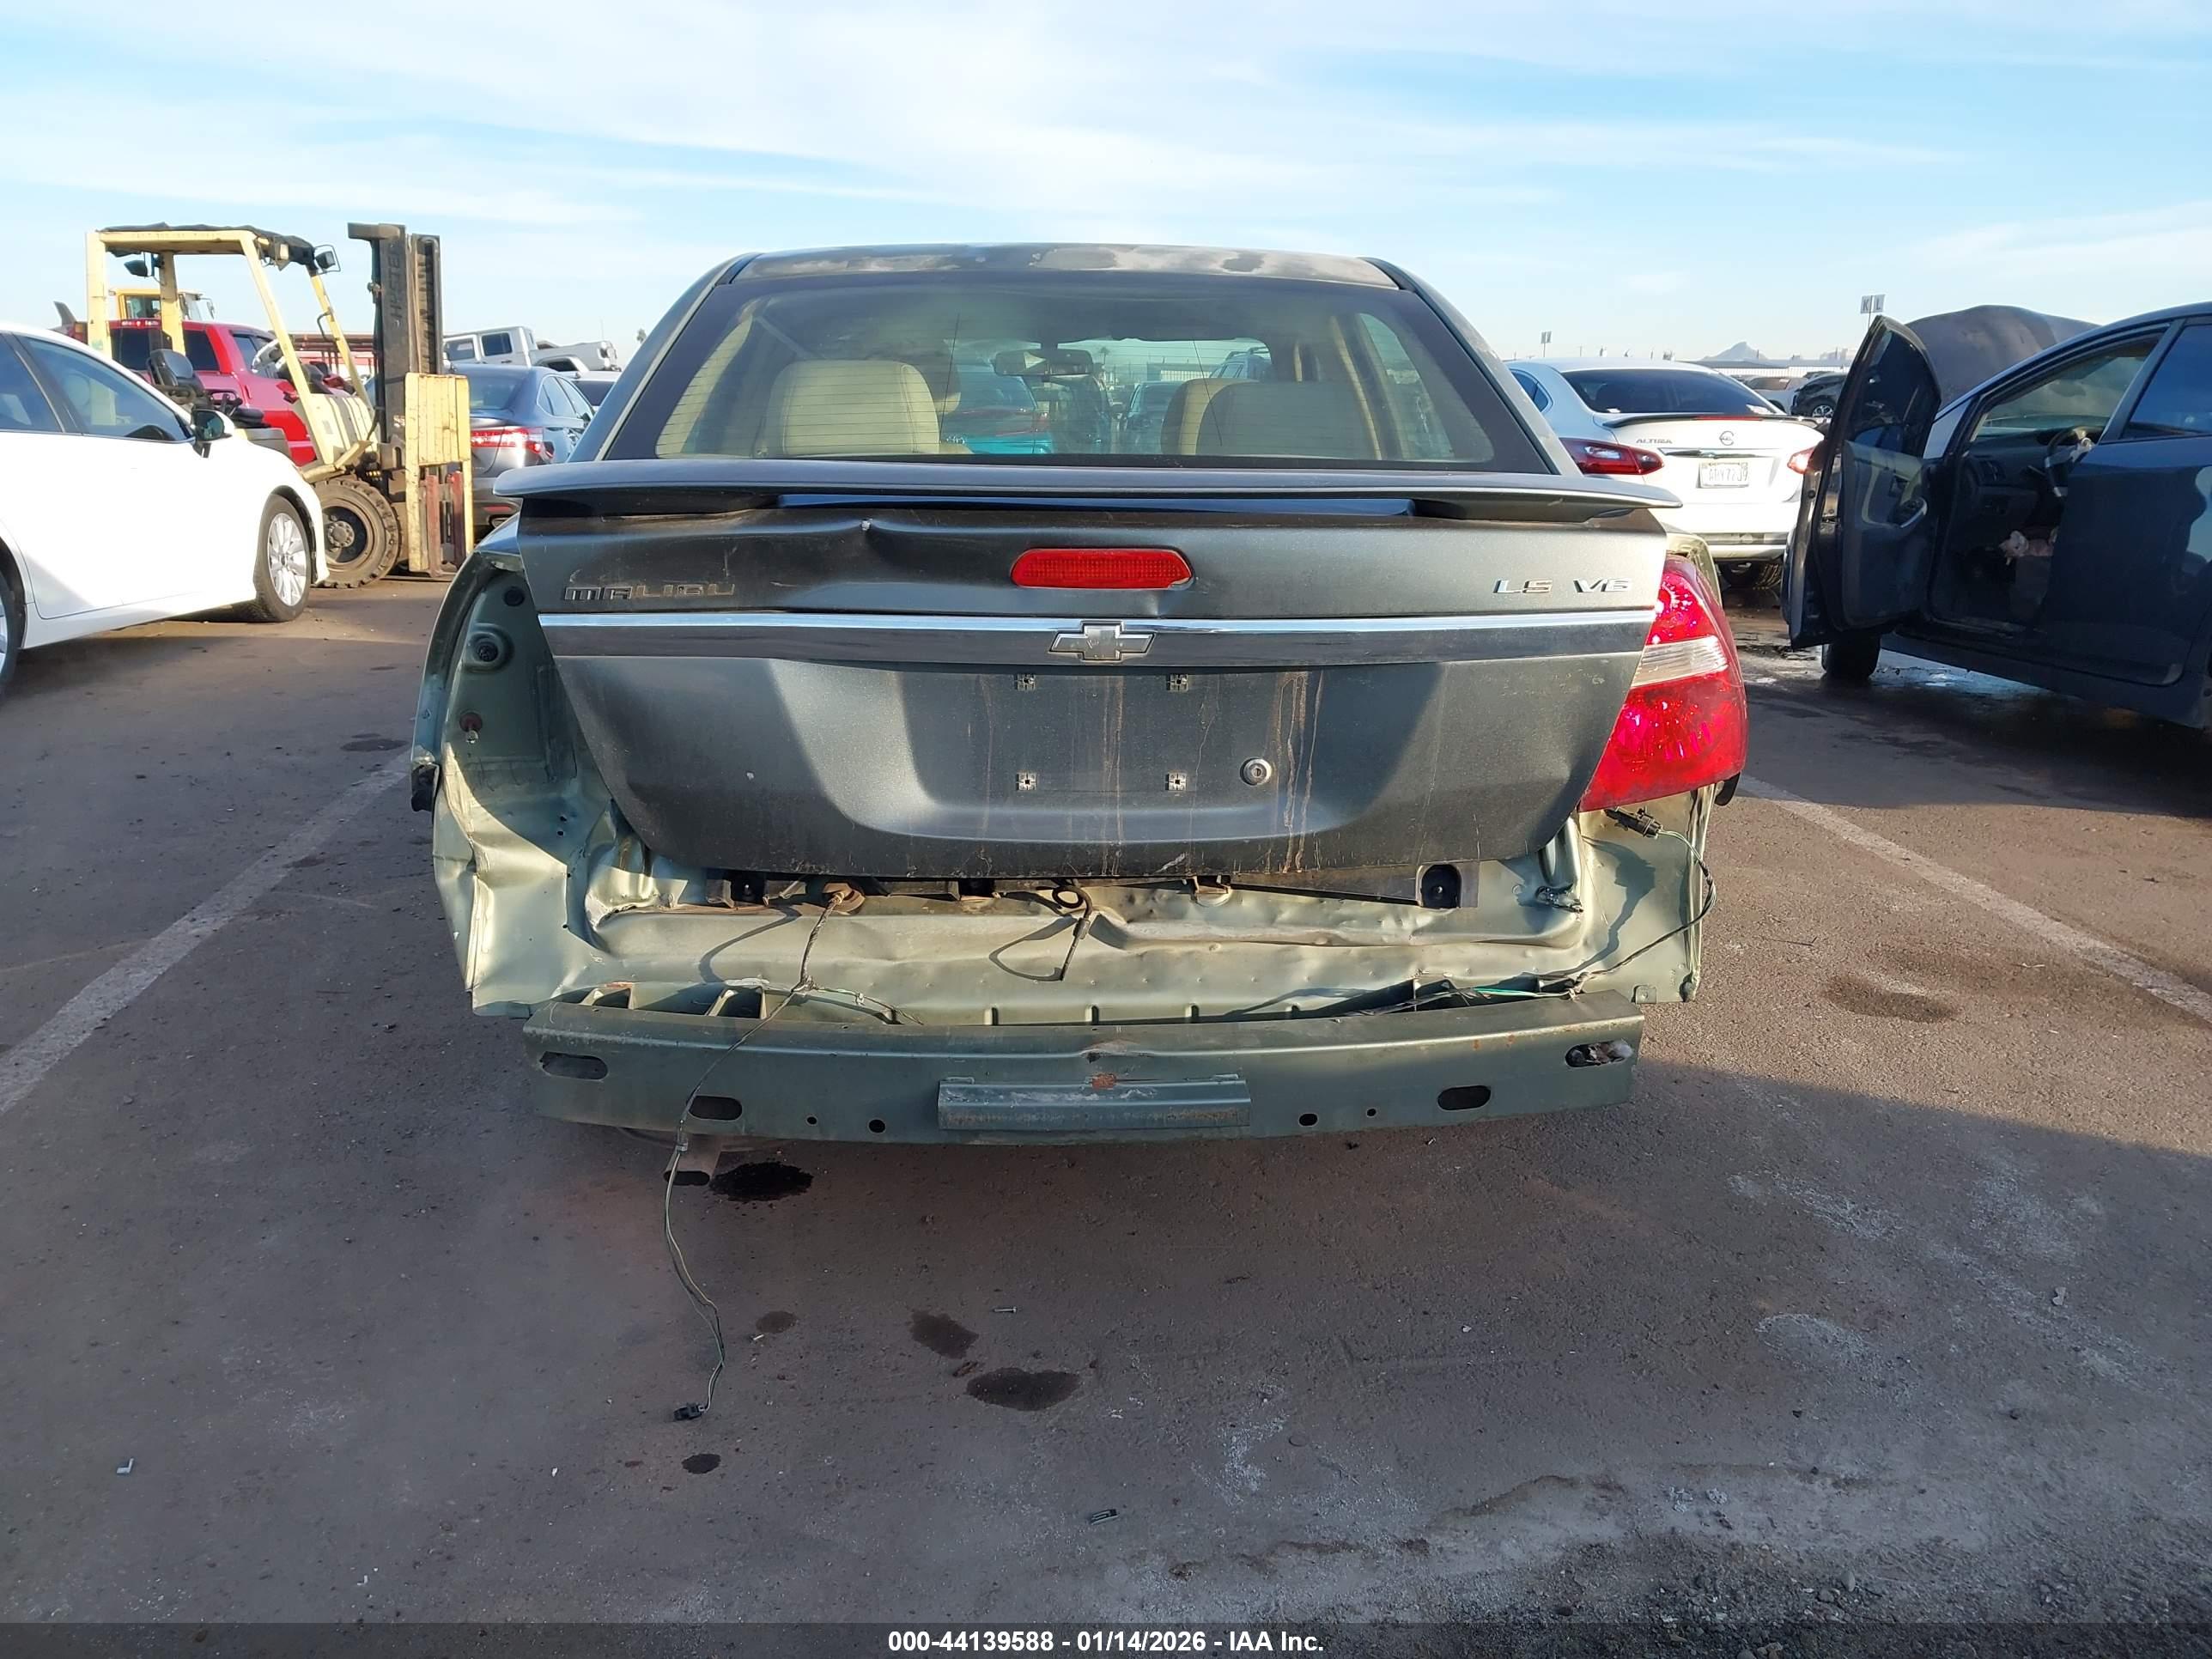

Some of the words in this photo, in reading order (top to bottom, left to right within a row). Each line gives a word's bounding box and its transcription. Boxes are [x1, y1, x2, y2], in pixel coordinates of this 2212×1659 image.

[1863, 298, 1869, 311] K
[1875, 298, 1881, 310] L
[1492, 578, 1553, 594] LS
[1573, 577, 1632, 593] V6
